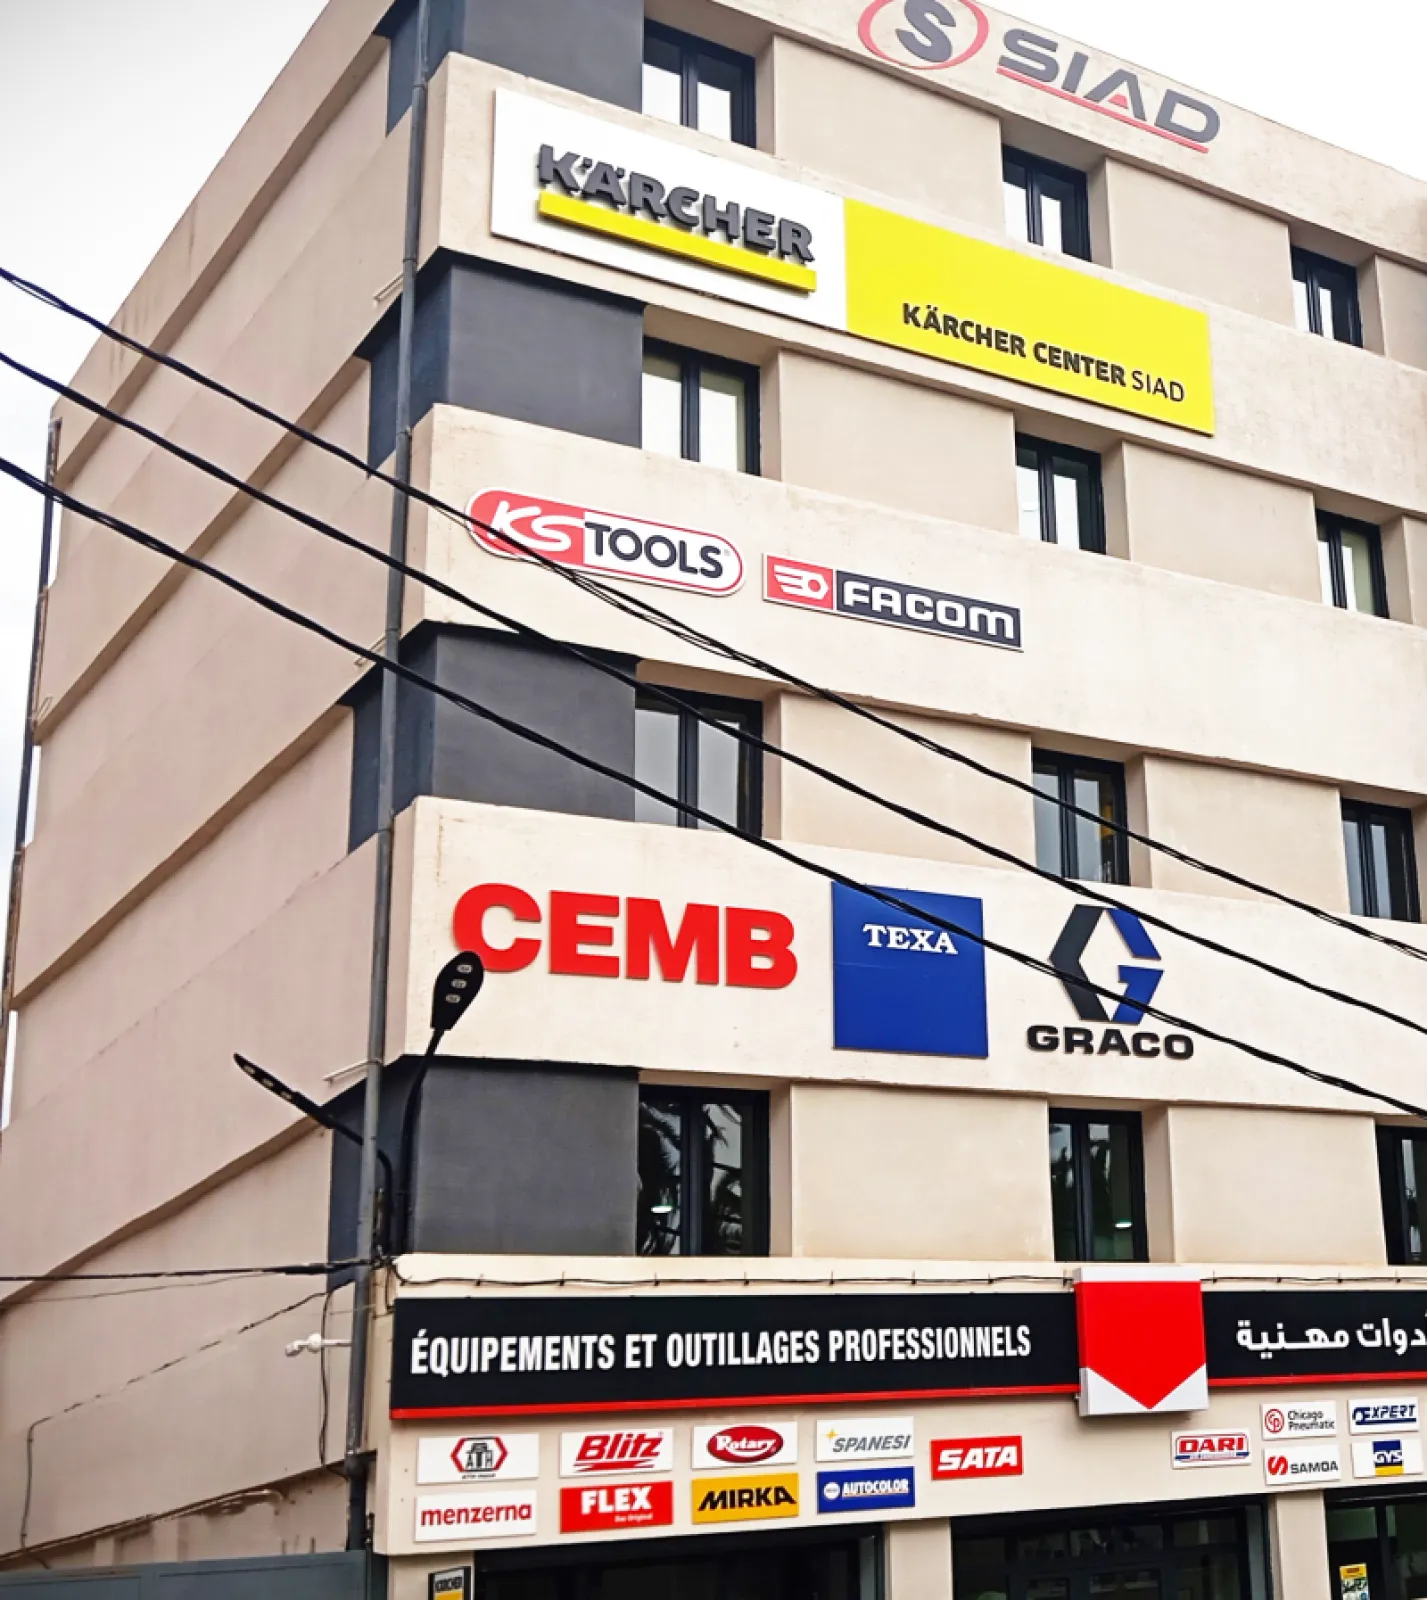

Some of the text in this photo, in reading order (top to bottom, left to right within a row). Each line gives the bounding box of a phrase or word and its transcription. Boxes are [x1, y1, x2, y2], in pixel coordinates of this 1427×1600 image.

[998, 28, 1221, 143] SIAD
[537, 144, 815, 263] KÄRCHER
[902, 302, 1185, 403] KÄRCHER CENTER SIAD
[489, 499, 722, 579] KS TOOLS
[843, 579, 1015, 639] FACOM
[452, 882, 798, 990] CEMB
[863, 923, 958, 955] TEXA
[1027, 1024, 1194, 1061] GRACO
[410, 1325, 1032, 1378] ÉQUIPEMENTS ET OUTILLAGES PROFESSIONNELS
[1235, 1319, 1350, 1359] مهنية
[1288, 1410, 1324, 1421] Chicago
[1288, 1420, 1335, 1432] Pneumatic
[576, 1432, 663, 1461] Blitz
[716, 1434, 777, 1454] Rotary
[832, 1434, 911, 1453] SPANESI
[1179, 1437, 1244, 1453] DARI
[1374, 1450, 1402, 1464] GYS
[937, 1446, 1018, 1472] SATA
[1290, 1460, 1339, 1475] SAMOA
[580, 1485, 652, 1515] FLEX
[697, 1485, 797, 1512] MIRKA
[842, 1478, 909, 1496] AUTOCOLOR
[420, 1503, 533, 1526] menzerna
